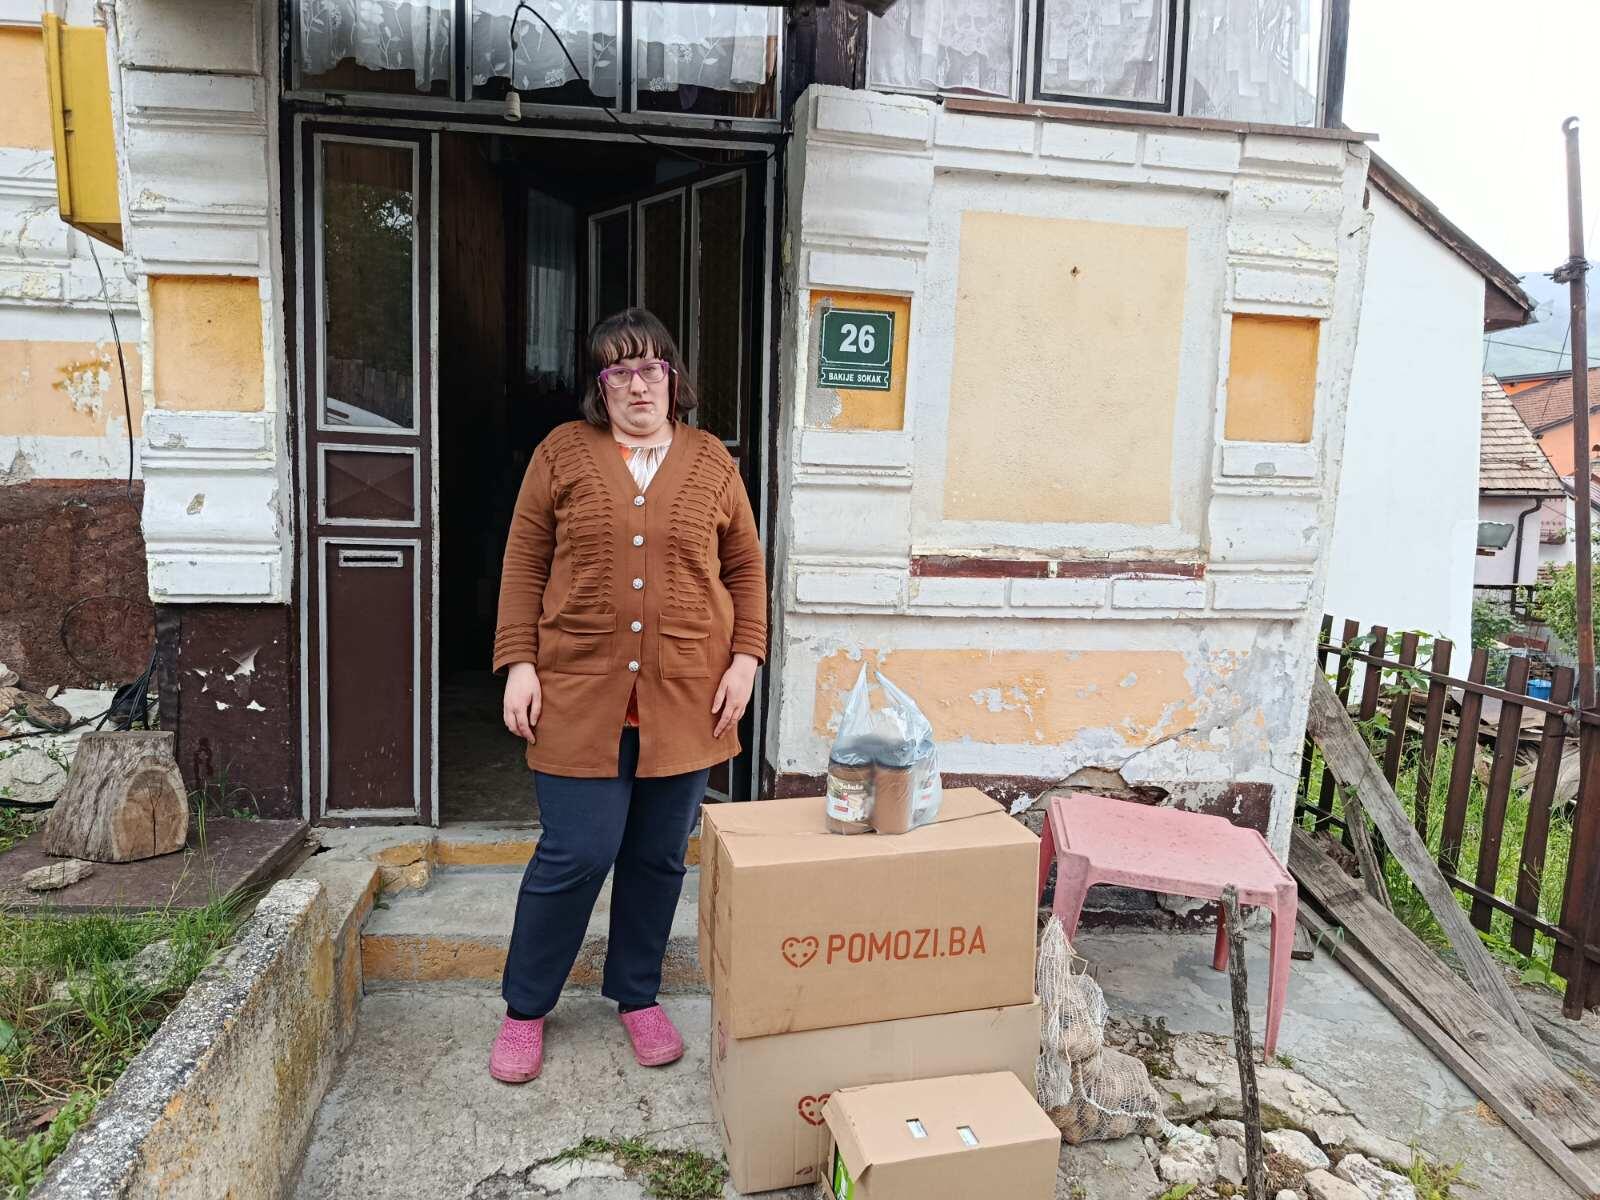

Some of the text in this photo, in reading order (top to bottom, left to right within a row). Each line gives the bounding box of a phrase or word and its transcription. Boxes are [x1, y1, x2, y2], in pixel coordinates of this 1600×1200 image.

[839, 323, 875, 354] 26
[828, 372, 881, 383] BAKIJE SOKAK
[826, 925, 986, 964] POMOZI.BA
